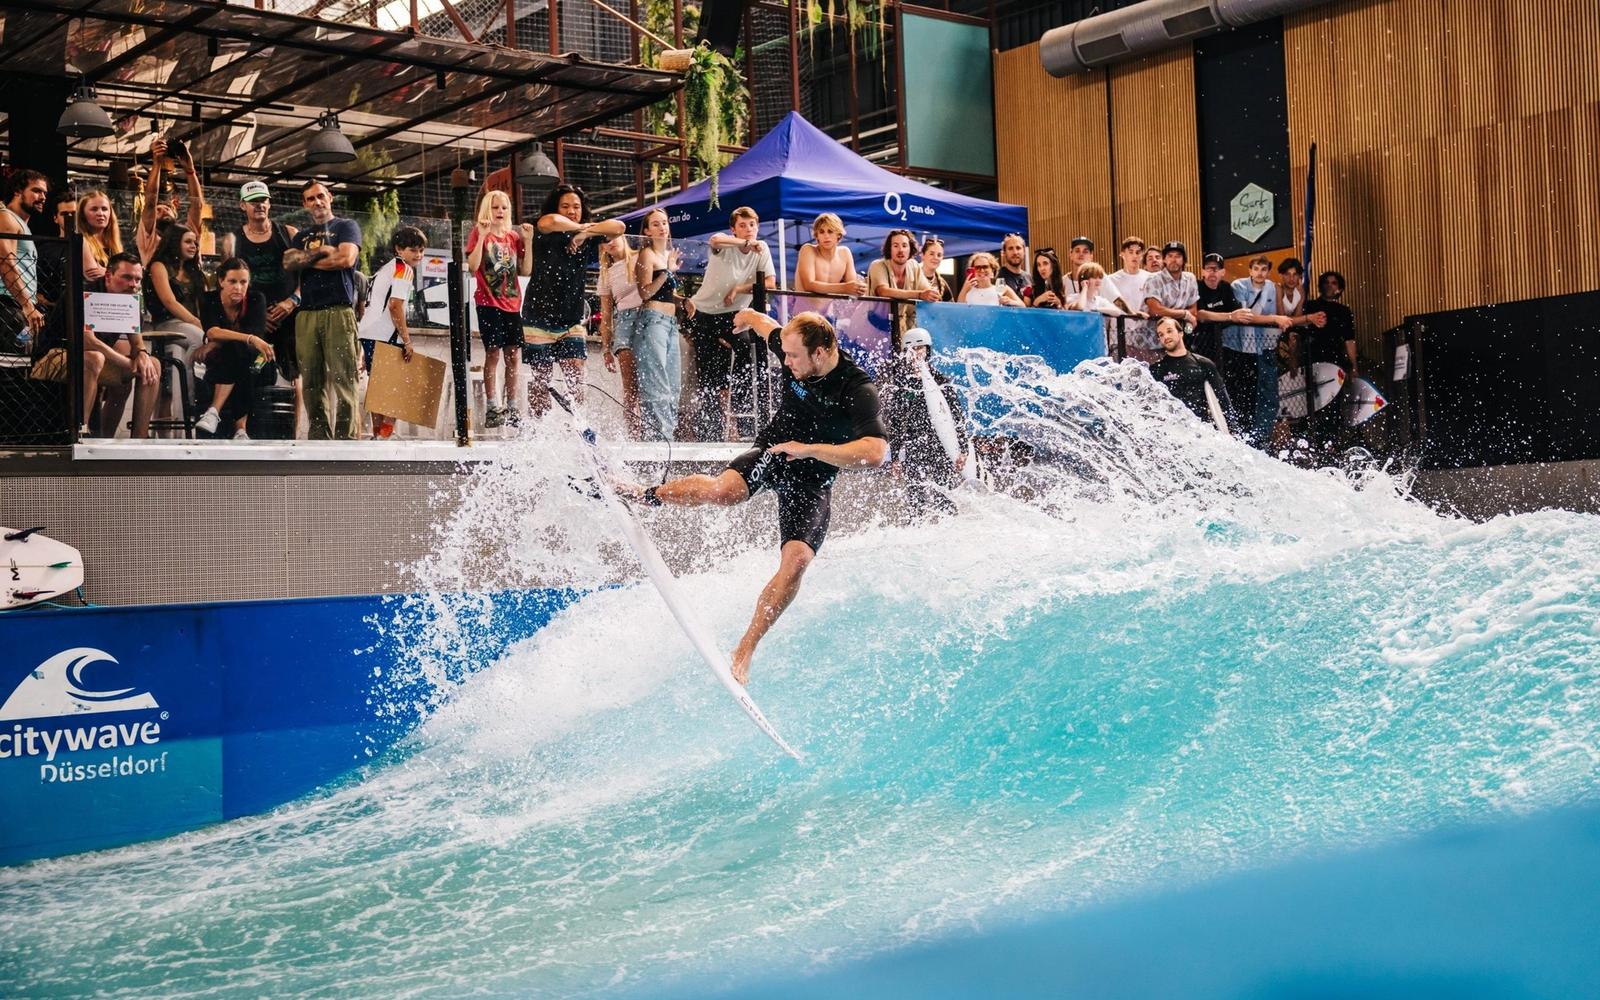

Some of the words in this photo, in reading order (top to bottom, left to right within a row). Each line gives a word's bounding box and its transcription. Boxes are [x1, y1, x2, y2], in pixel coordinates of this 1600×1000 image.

[669, 215, 681, 223] can
[681, 211, 691, 221] do
[884, 191, 907, 221] O2
[909, 204, 924, 214] can
[924, 205, 935, 216] do
[41, 751, 168, 784] Düsseldorf
